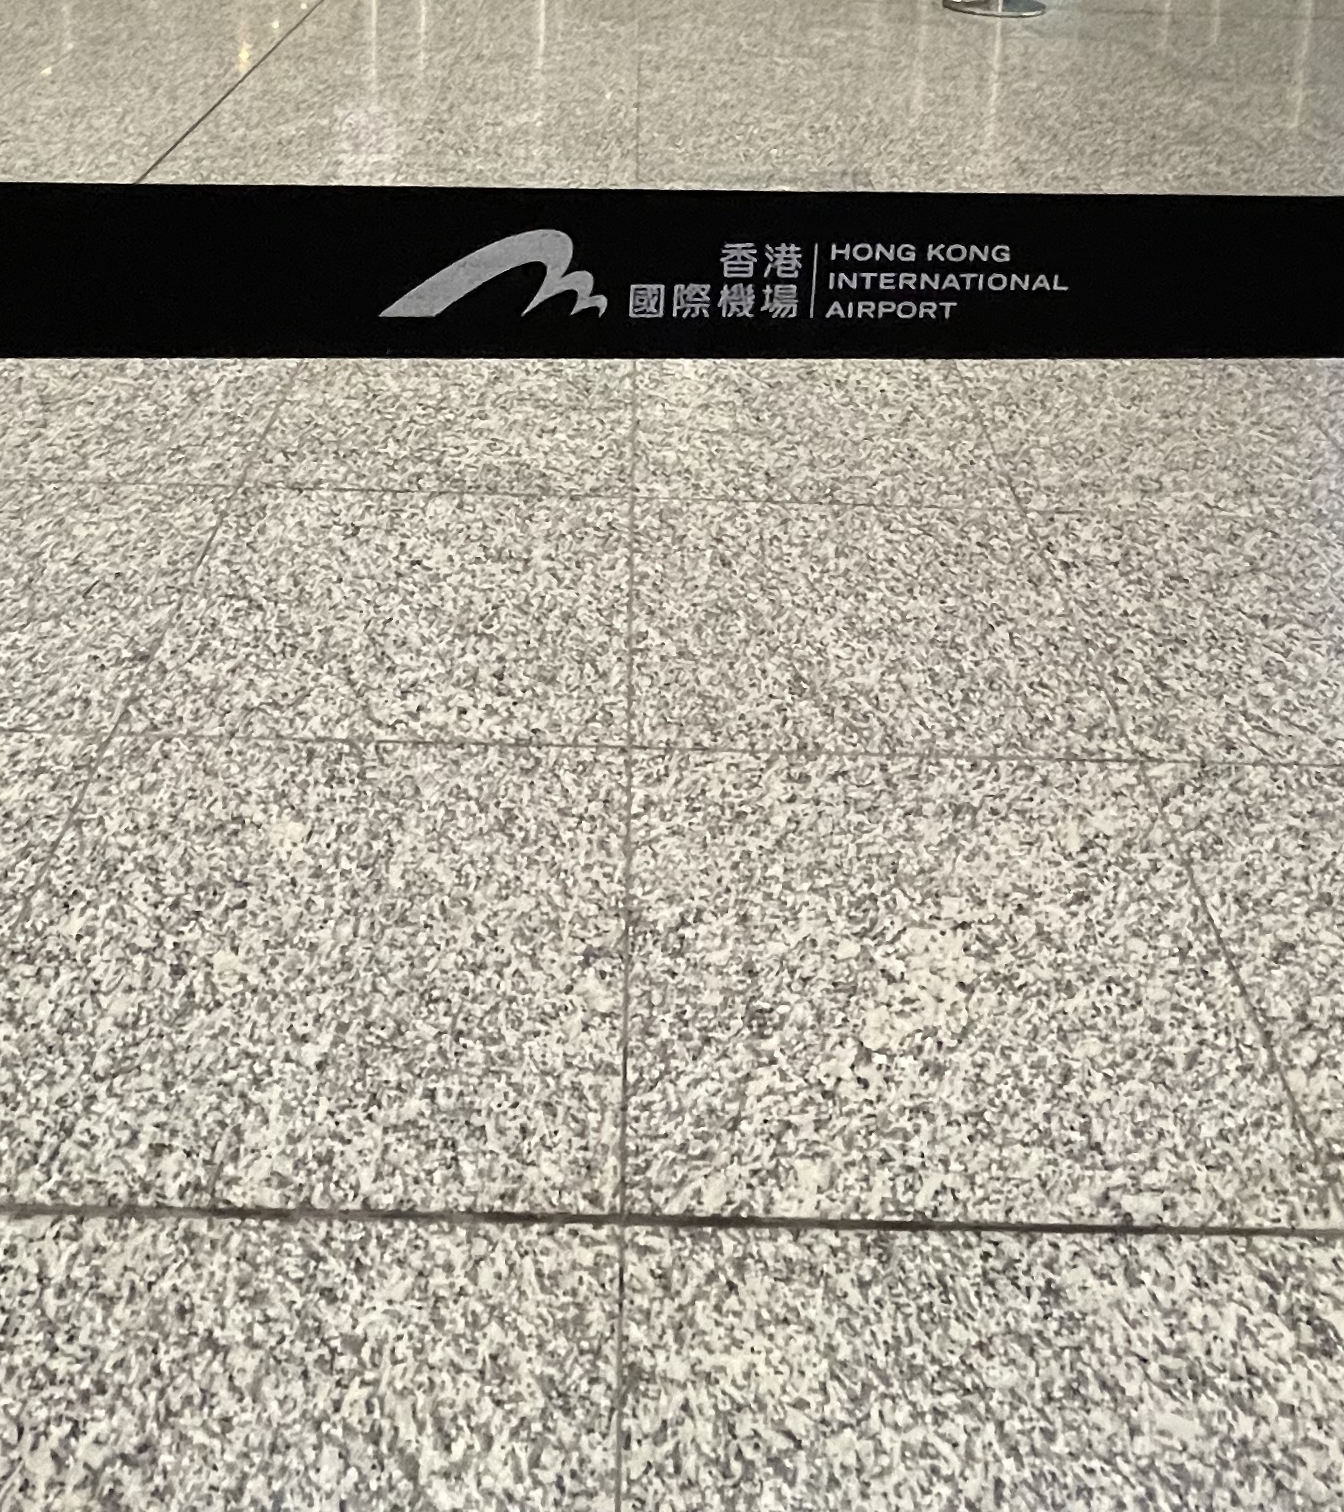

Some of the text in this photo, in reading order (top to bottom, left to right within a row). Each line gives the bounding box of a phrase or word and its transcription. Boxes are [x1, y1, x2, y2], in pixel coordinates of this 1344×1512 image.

[719, 242, 803, 279] 香港
[830, 242, 1011, 263] HONG KONG
[828, 272, 1069, 291] INTERNATIONAL
[628, 283, 799, 319] 國際機場
[824, 300, 958, 319] AIRPORT
